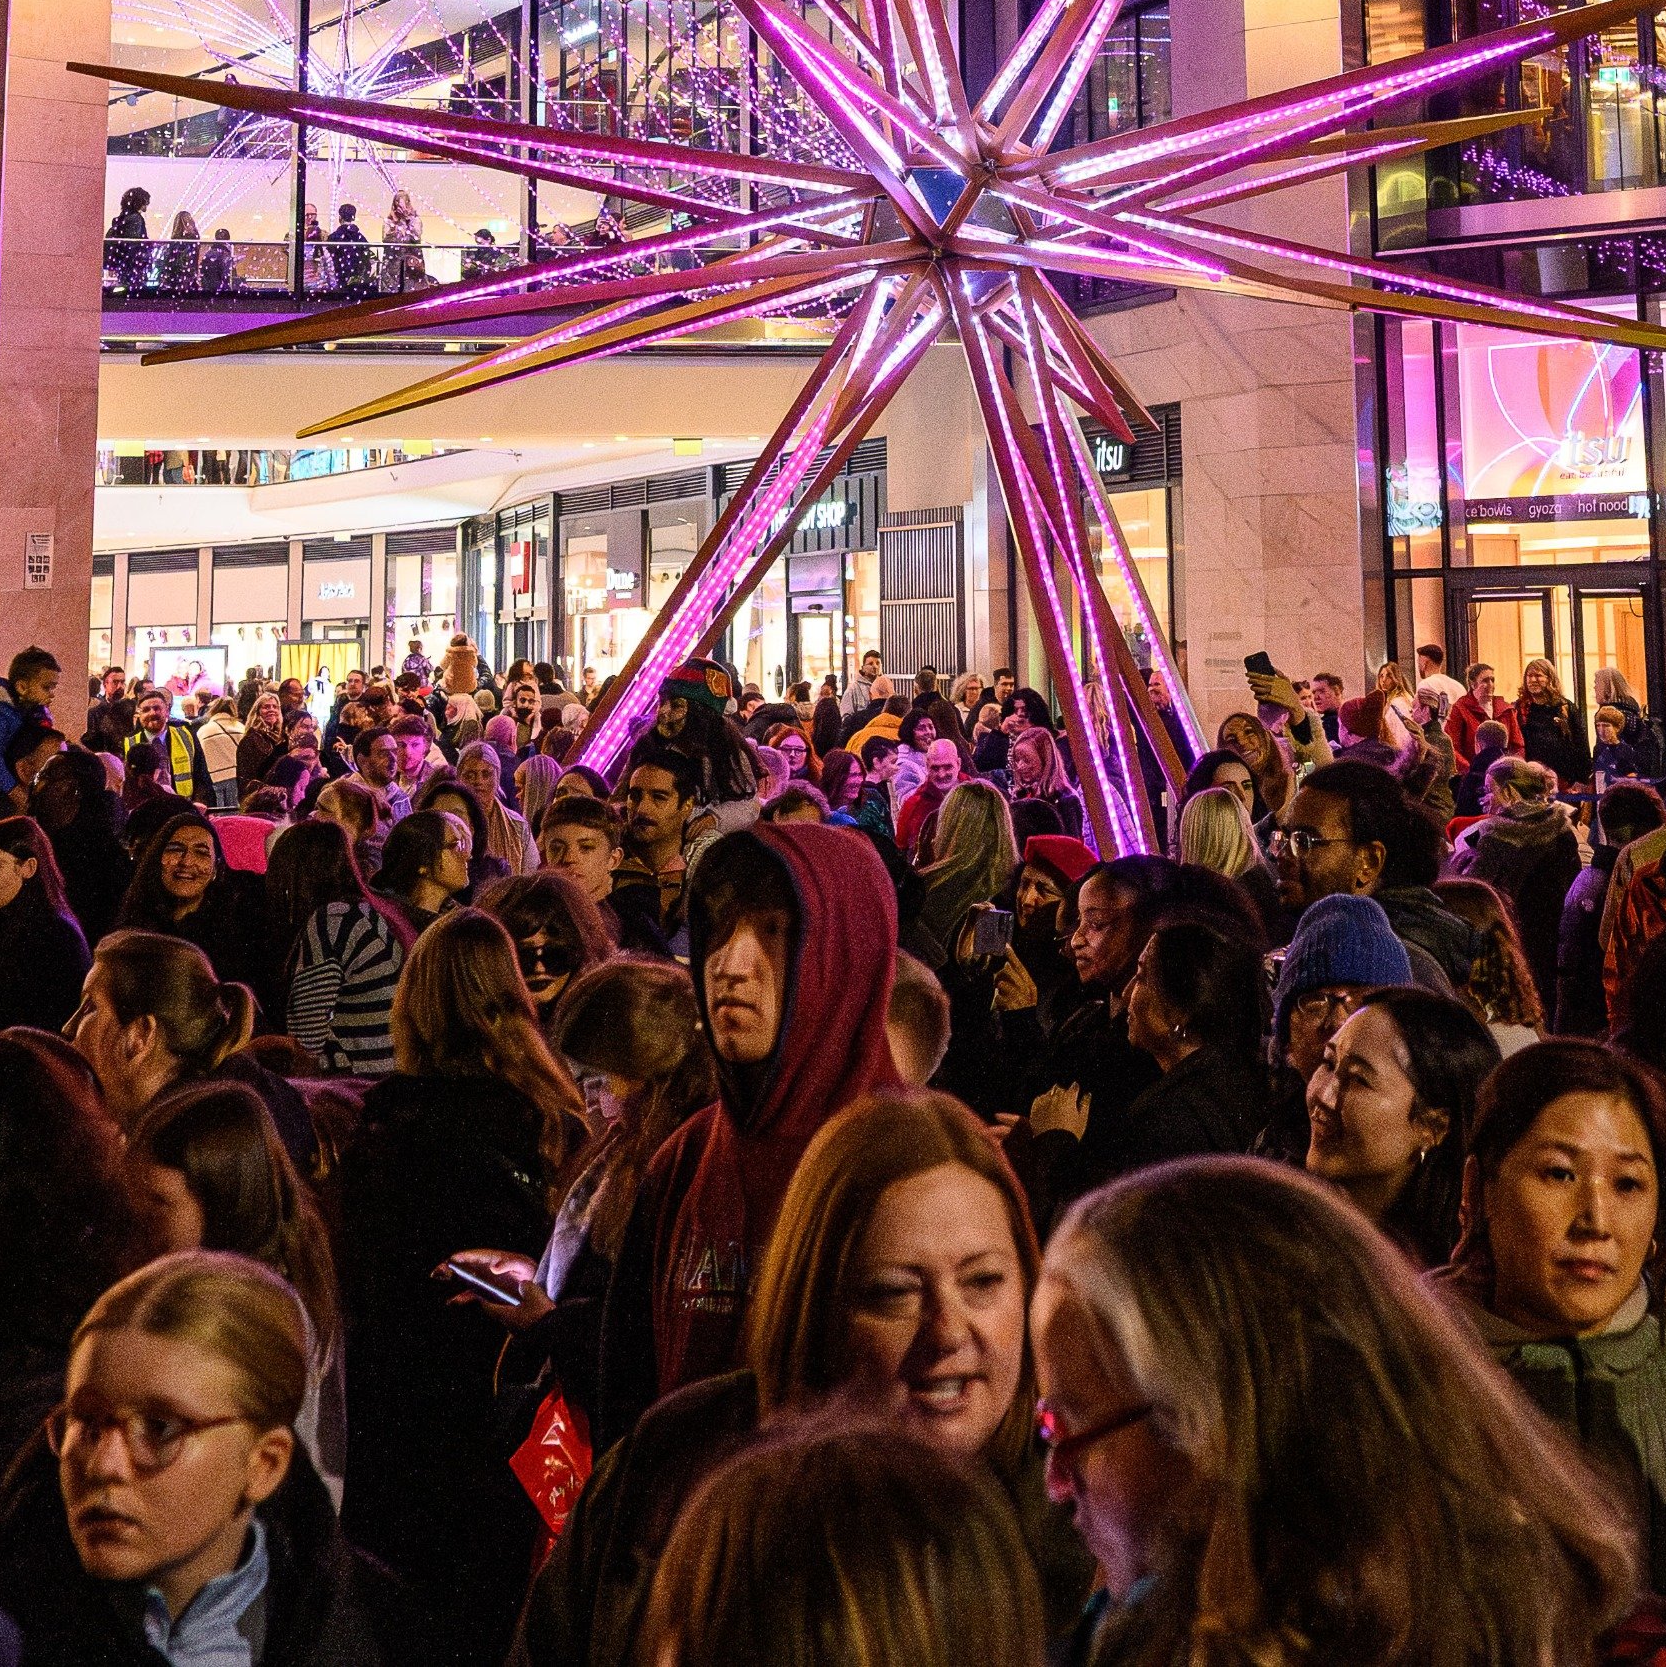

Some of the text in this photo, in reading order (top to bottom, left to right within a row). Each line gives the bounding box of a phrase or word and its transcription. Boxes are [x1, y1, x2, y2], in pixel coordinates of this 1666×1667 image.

[1096, 437, 1123, 472] itsu
[816, 501, 845, 528] SHOP
[1528, 503, 1562, 521] gyoza
[1578, 497, 1597, 514] hot
